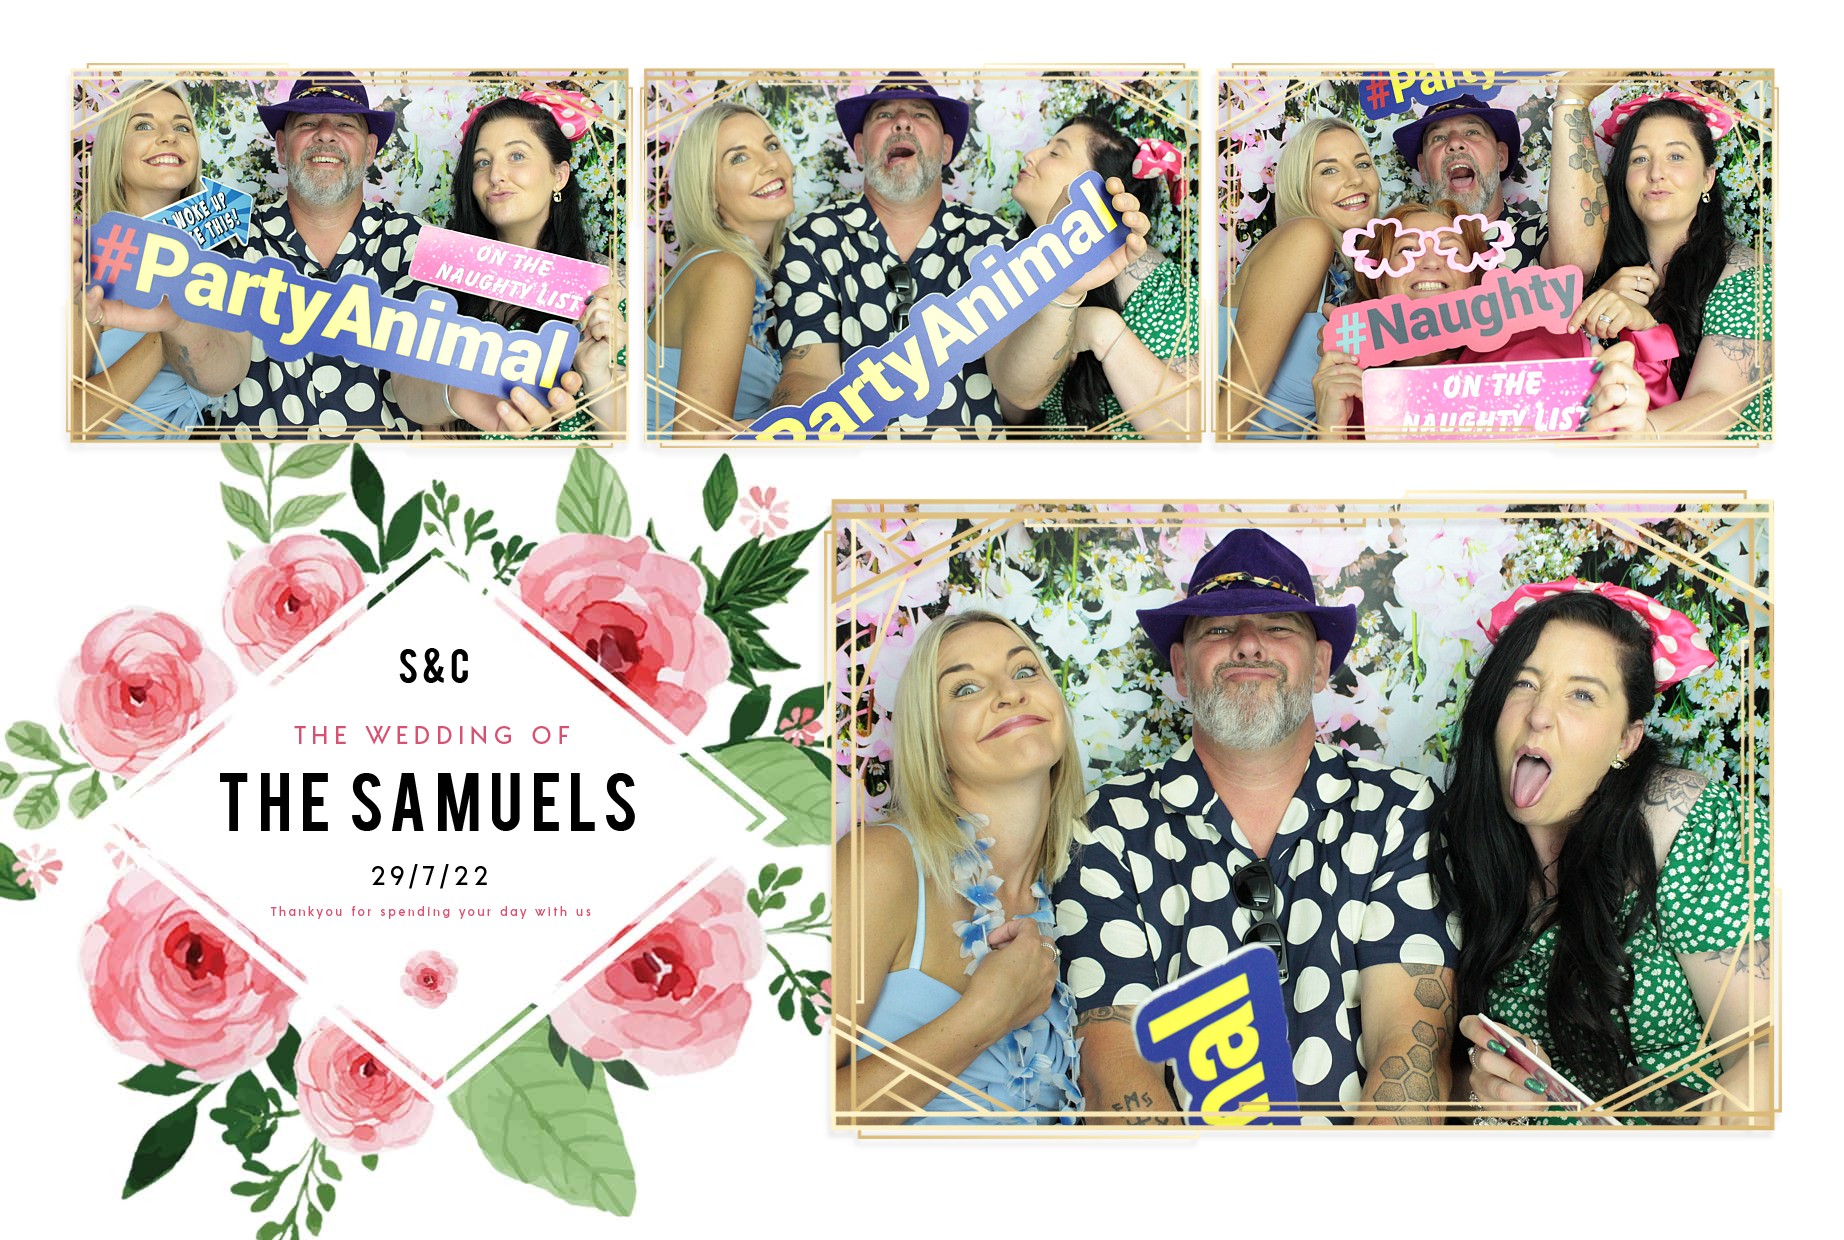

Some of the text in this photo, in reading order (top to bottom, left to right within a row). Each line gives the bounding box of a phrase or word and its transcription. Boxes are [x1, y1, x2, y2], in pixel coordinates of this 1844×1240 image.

[172, 192, 228, 230] WOKE UP
[204, 208, 241, 239] THIS!
[476, 245, 553, 277] ON THE
[435, 262, 584, 314] NAUGHTY LIST
[91, 223, 570, 390] #PartyAnimal
[1336, 273, 1576, 356] #Naughty
[1443, 371, 1543, 399] ON THE
[1402, 408, 1527, 433] NAUGHTY
